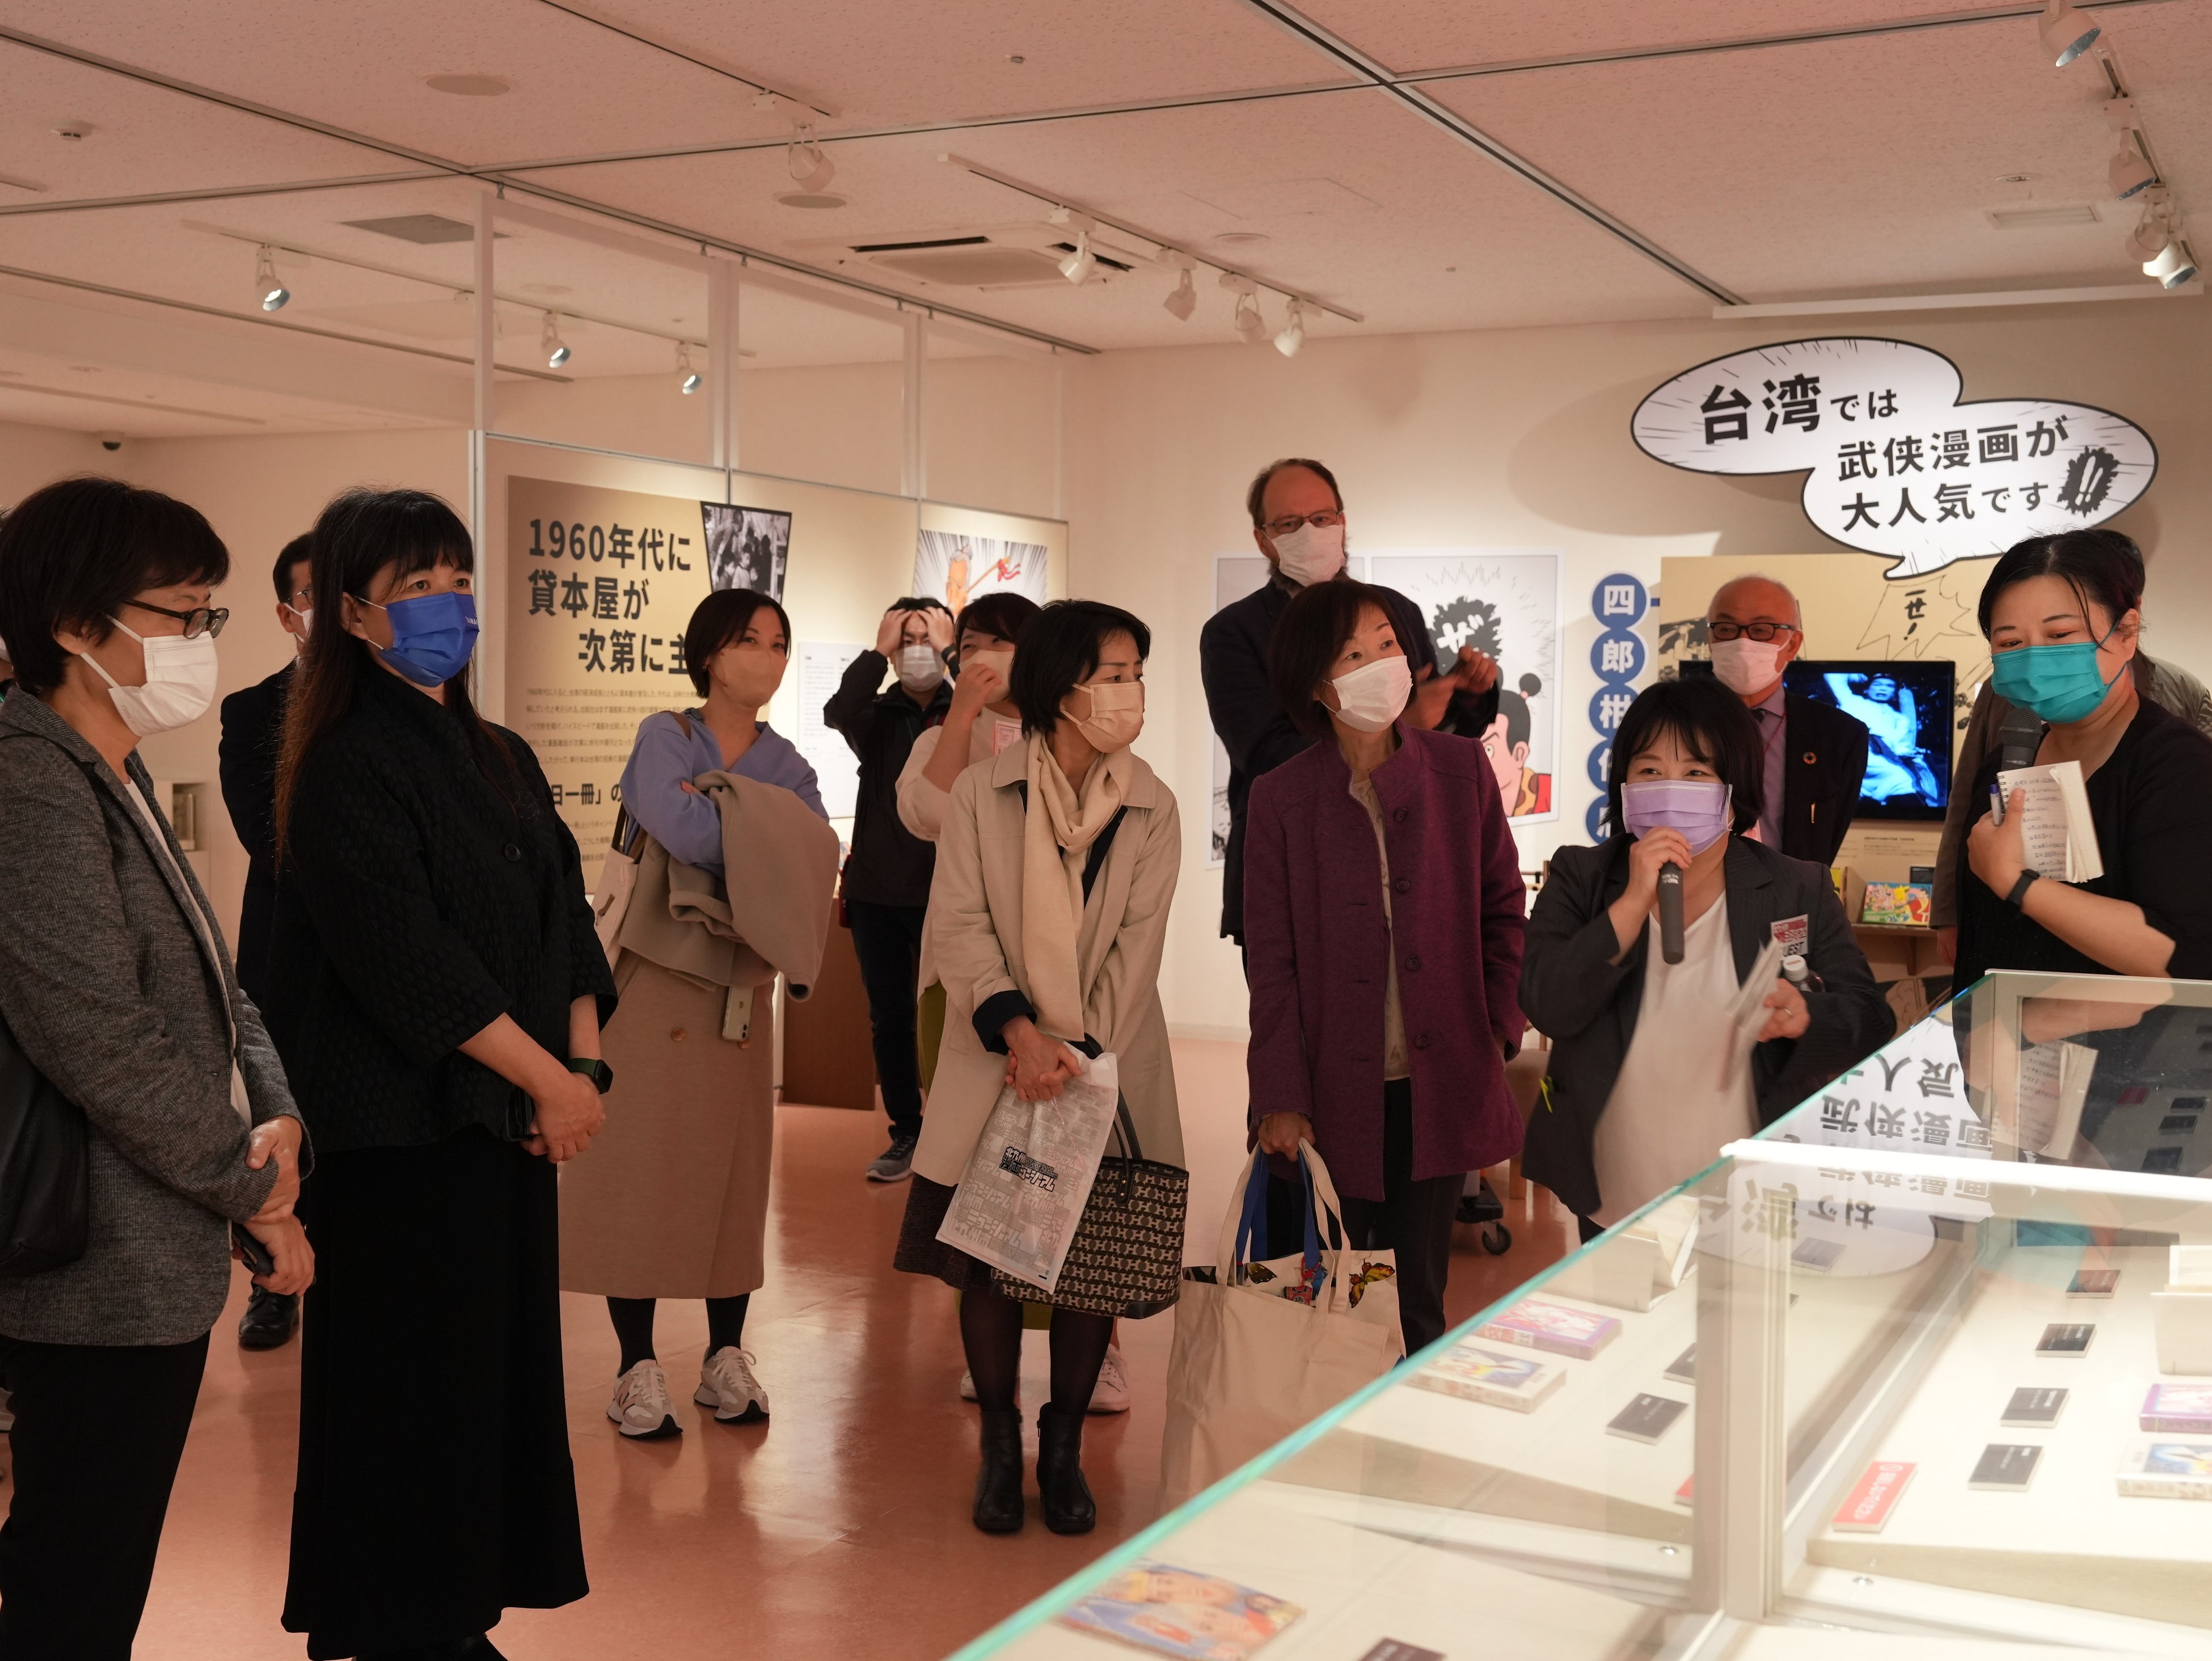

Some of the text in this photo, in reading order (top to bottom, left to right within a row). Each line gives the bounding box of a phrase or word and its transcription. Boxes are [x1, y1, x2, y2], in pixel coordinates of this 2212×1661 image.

[1700, 373, 1898, 444] 台湾では
[1837, 414, 2069, 482] 武侠漫画が
[530, 518, 691, 571] 1960年代に
[528, 568, 649, 619] 貸本屋が
